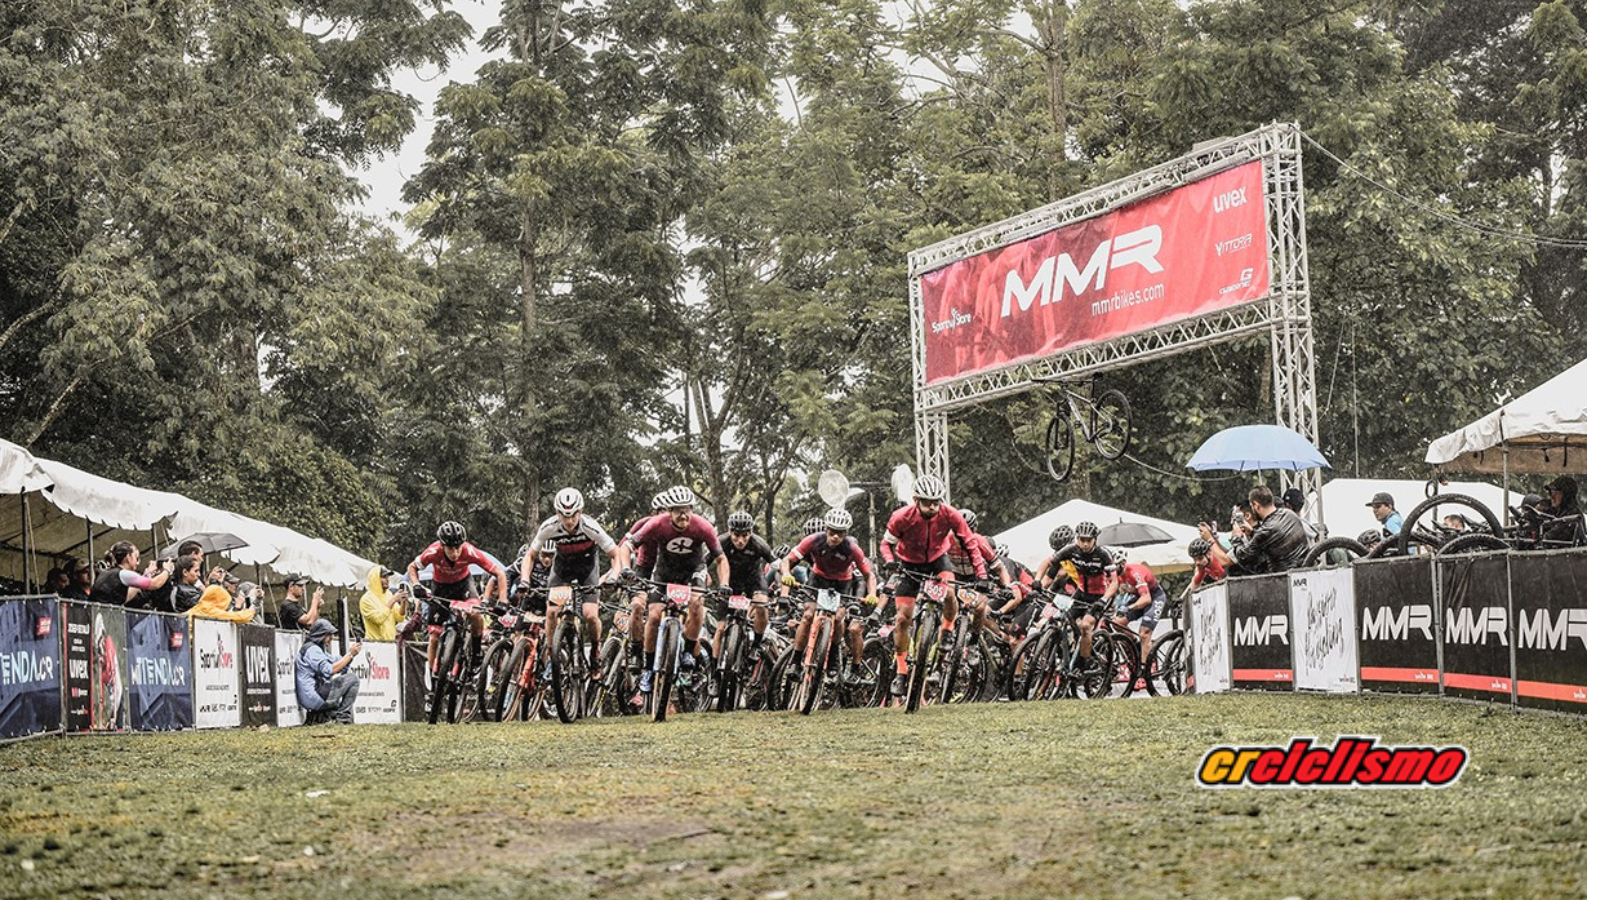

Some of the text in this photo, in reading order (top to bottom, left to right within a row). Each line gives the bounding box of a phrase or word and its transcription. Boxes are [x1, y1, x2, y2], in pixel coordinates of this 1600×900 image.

[1213, 186, 1248, 213] uvex
[1001, 224, 1165, 318] MMR
[1092, 283, 1165, 317] mmrbikes.com
[1234, 614, 1289, 647] MMR
[1362, 604, 1434, 641] MMR
[1445, 606, 1509, 646] MMR
[1518, 608, 1587, 651] MMR
[372, 660, 390, 680] Store
